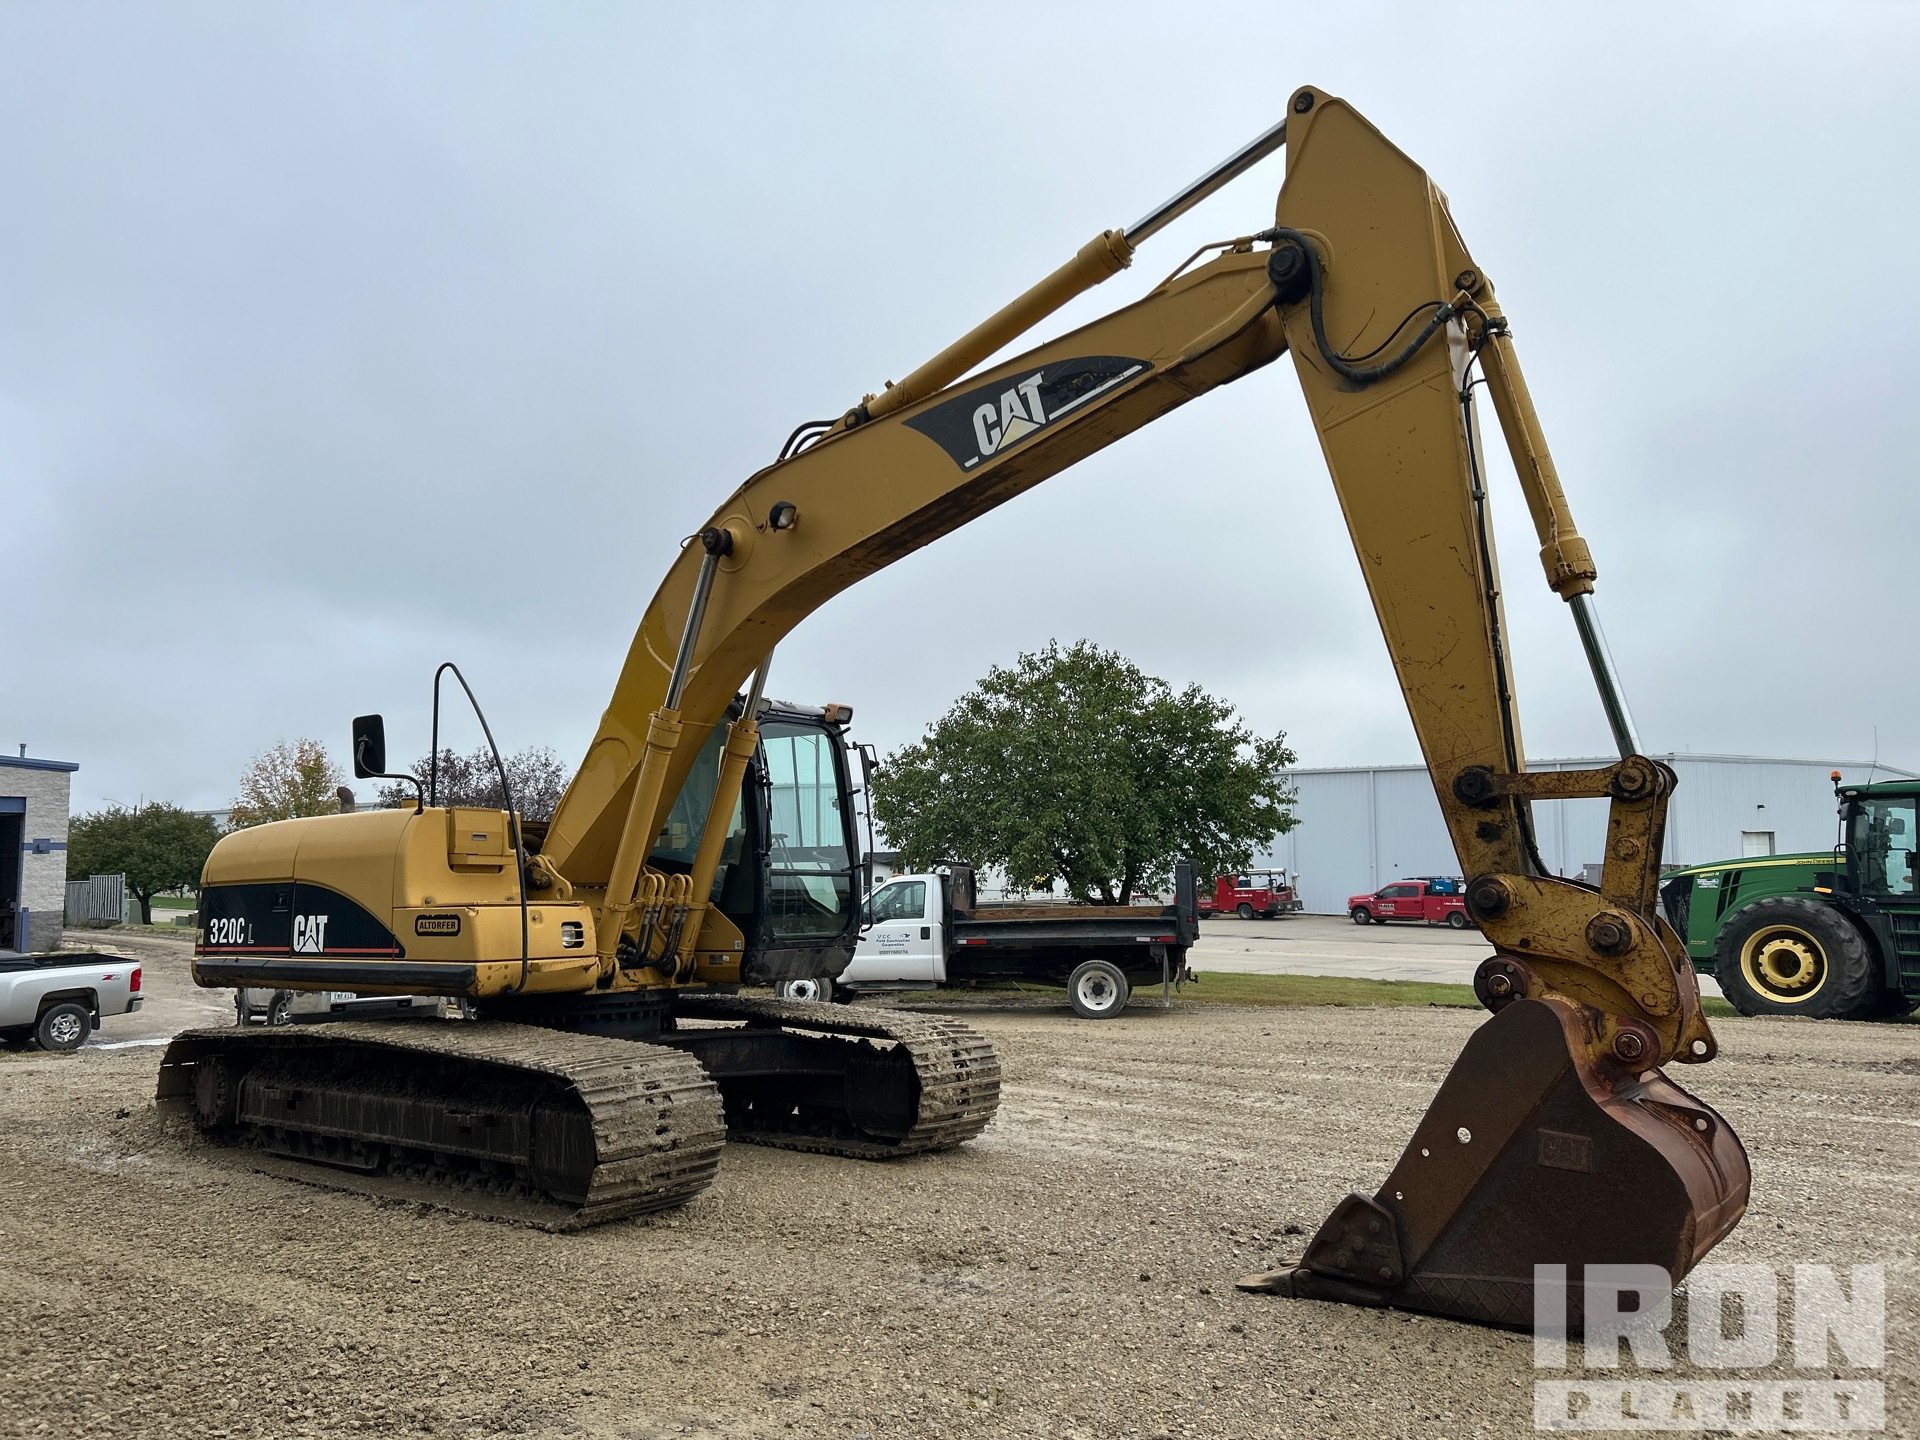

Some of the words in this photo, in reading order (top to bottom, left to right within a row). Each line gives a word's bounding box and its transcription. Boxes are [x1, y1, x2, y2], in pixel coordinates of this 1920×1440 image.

[973, 371, 1046, 456] CAT
[210, 917, 245, 944] 320C
[247, 923, 254, 944] L
[293, 915, 328, 953] CAT
[419, 921, 456, 930] ALTORFER
